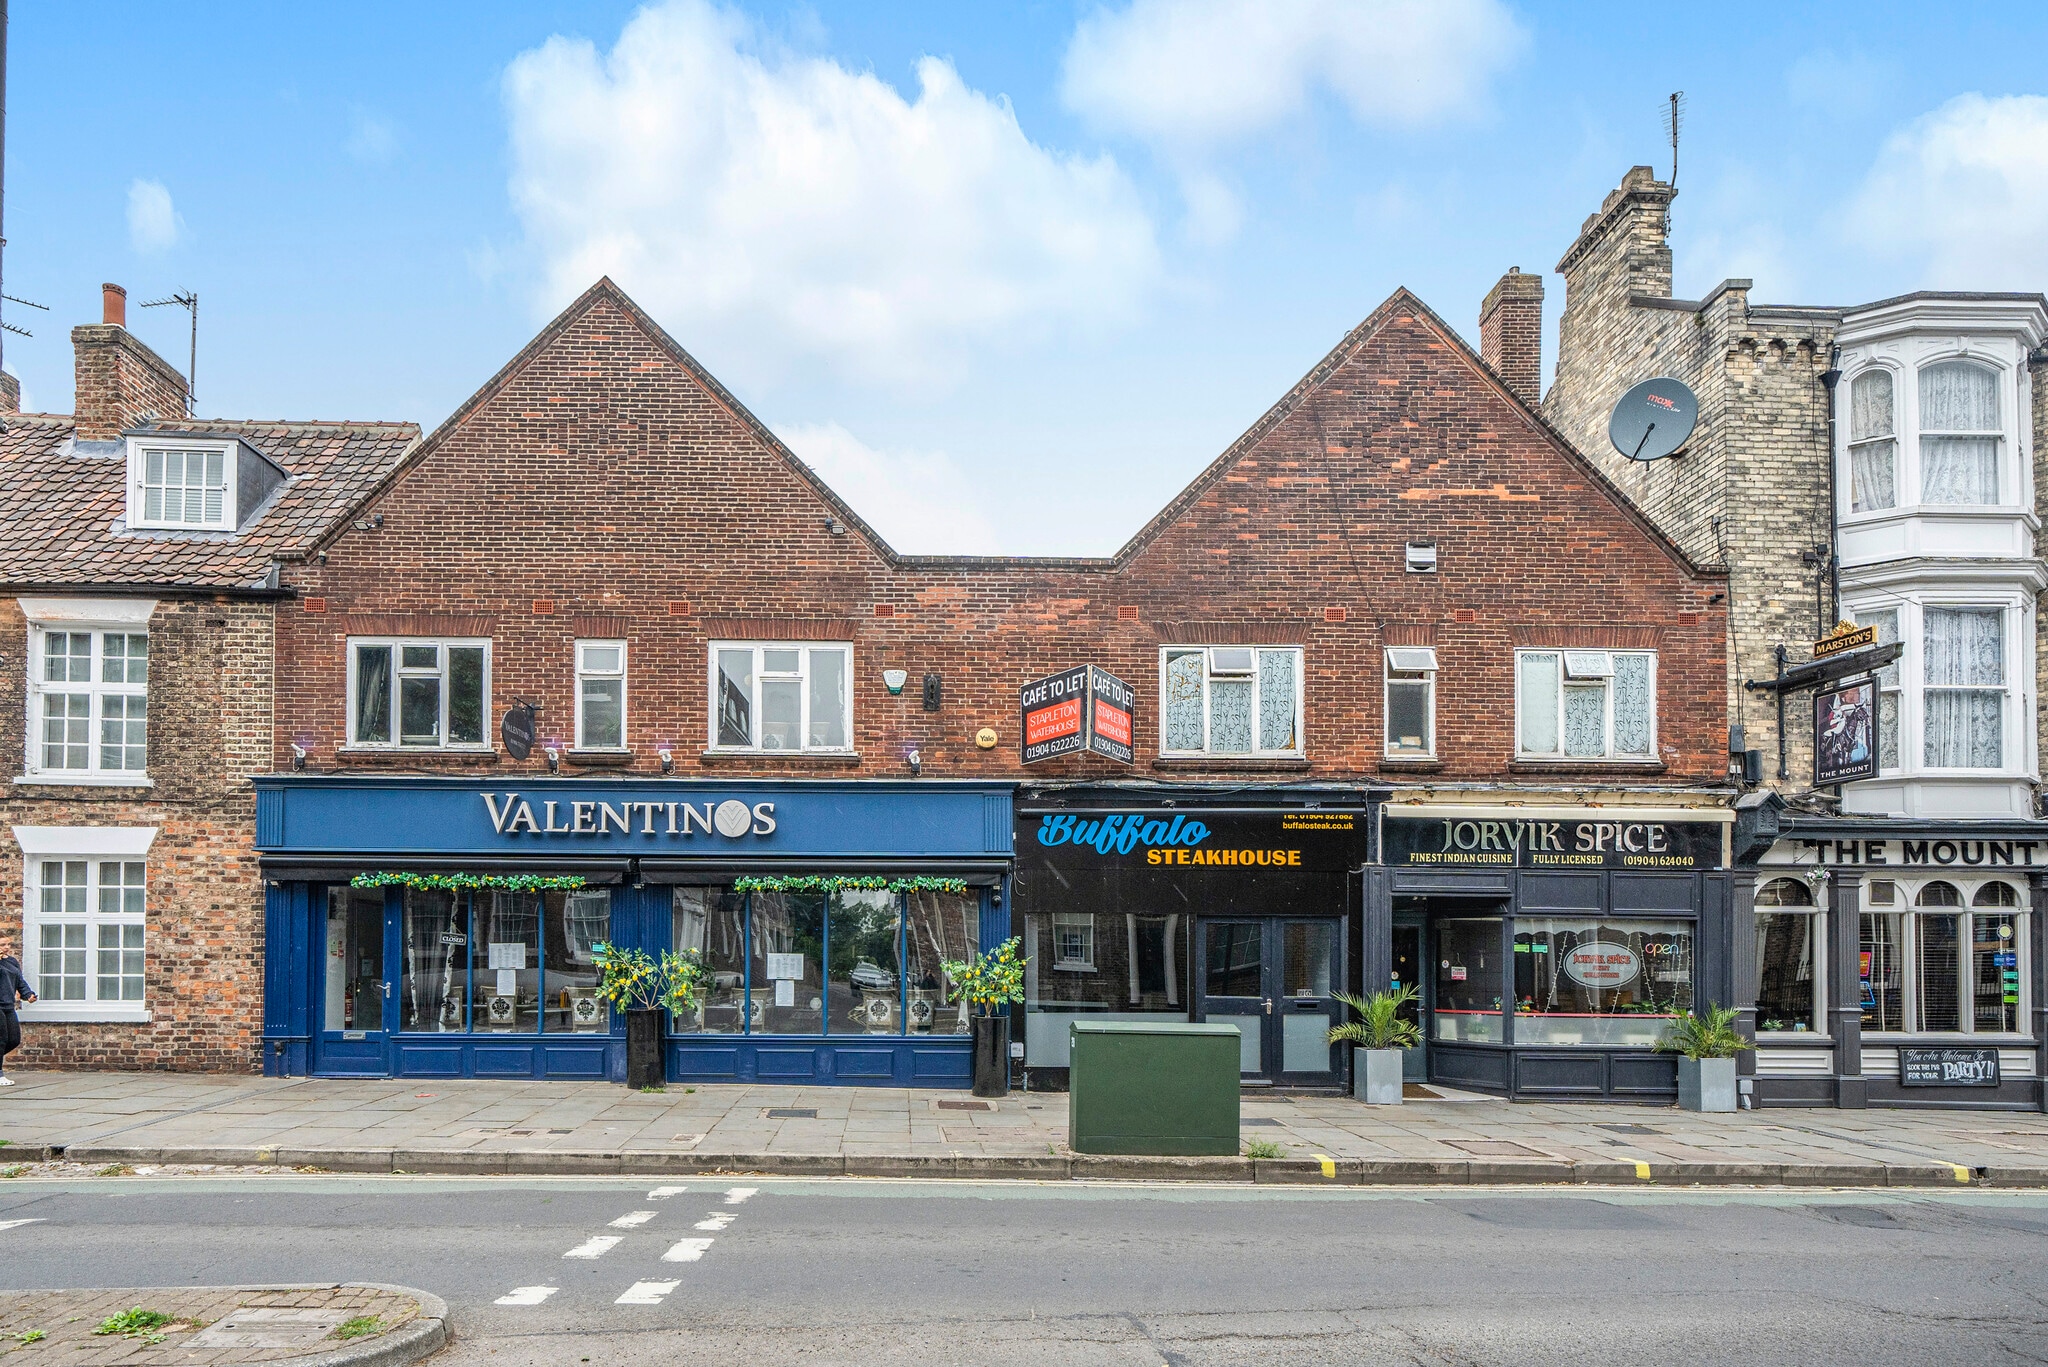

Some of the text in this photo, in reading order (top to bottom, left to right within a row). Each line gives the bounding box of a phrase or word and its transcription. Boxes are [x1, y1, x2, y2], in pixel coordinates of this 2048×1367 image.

[1816, 630, 1871, 655] MARSTON'S
[1022, 672, 1086, 706] CAFÉ TO LET
[1092, 673, 1134, 708] CAFÉ TO LET
[1030, 703, 1077, 727] STAPLETON
[1097, 704, 1129, 728] STAPLETON
[1030, 719, 1077, 739] WATERHOUSE
[1097, 719, 1129, 741] WATERHOUSE
[1026, 735, 1080, 759] 01904 622226
[1094, 736, 1132, 760] 01904 622226
[1820, 764, 1869, 778] THE MOUNT
[480, 793, 776, 838] VALENTINOS
[1282, 822, 1354, 830] buffalosteak.co.uk
[1037, 815, 1212, 855] Buffalo
[1441, 817, 1668, 853] JORVIK SPICE
[1147, 849, 1302, 866] STEAKHOUSE
[1410, 853, 1513, 864] FINEST INDIAN CUISINE
[1533, 855, 1603, 865] FULLY LICENSED
[1623, 855, 1694, 866] (01904) 624040
[1807, 839, 2039, 865] THE MOUNT
[1645, 943, 1679, 957] open
[1907, 1049, 1922, 1063] You
[1941, 1049, 1972, 1061] Welcome
[1907, 1063, 1921, 1071] BOOK
[1907, 1072, 1939, 1080] FOR YOUR
[1942, 1060, 1995, 1081] PARTY!!
